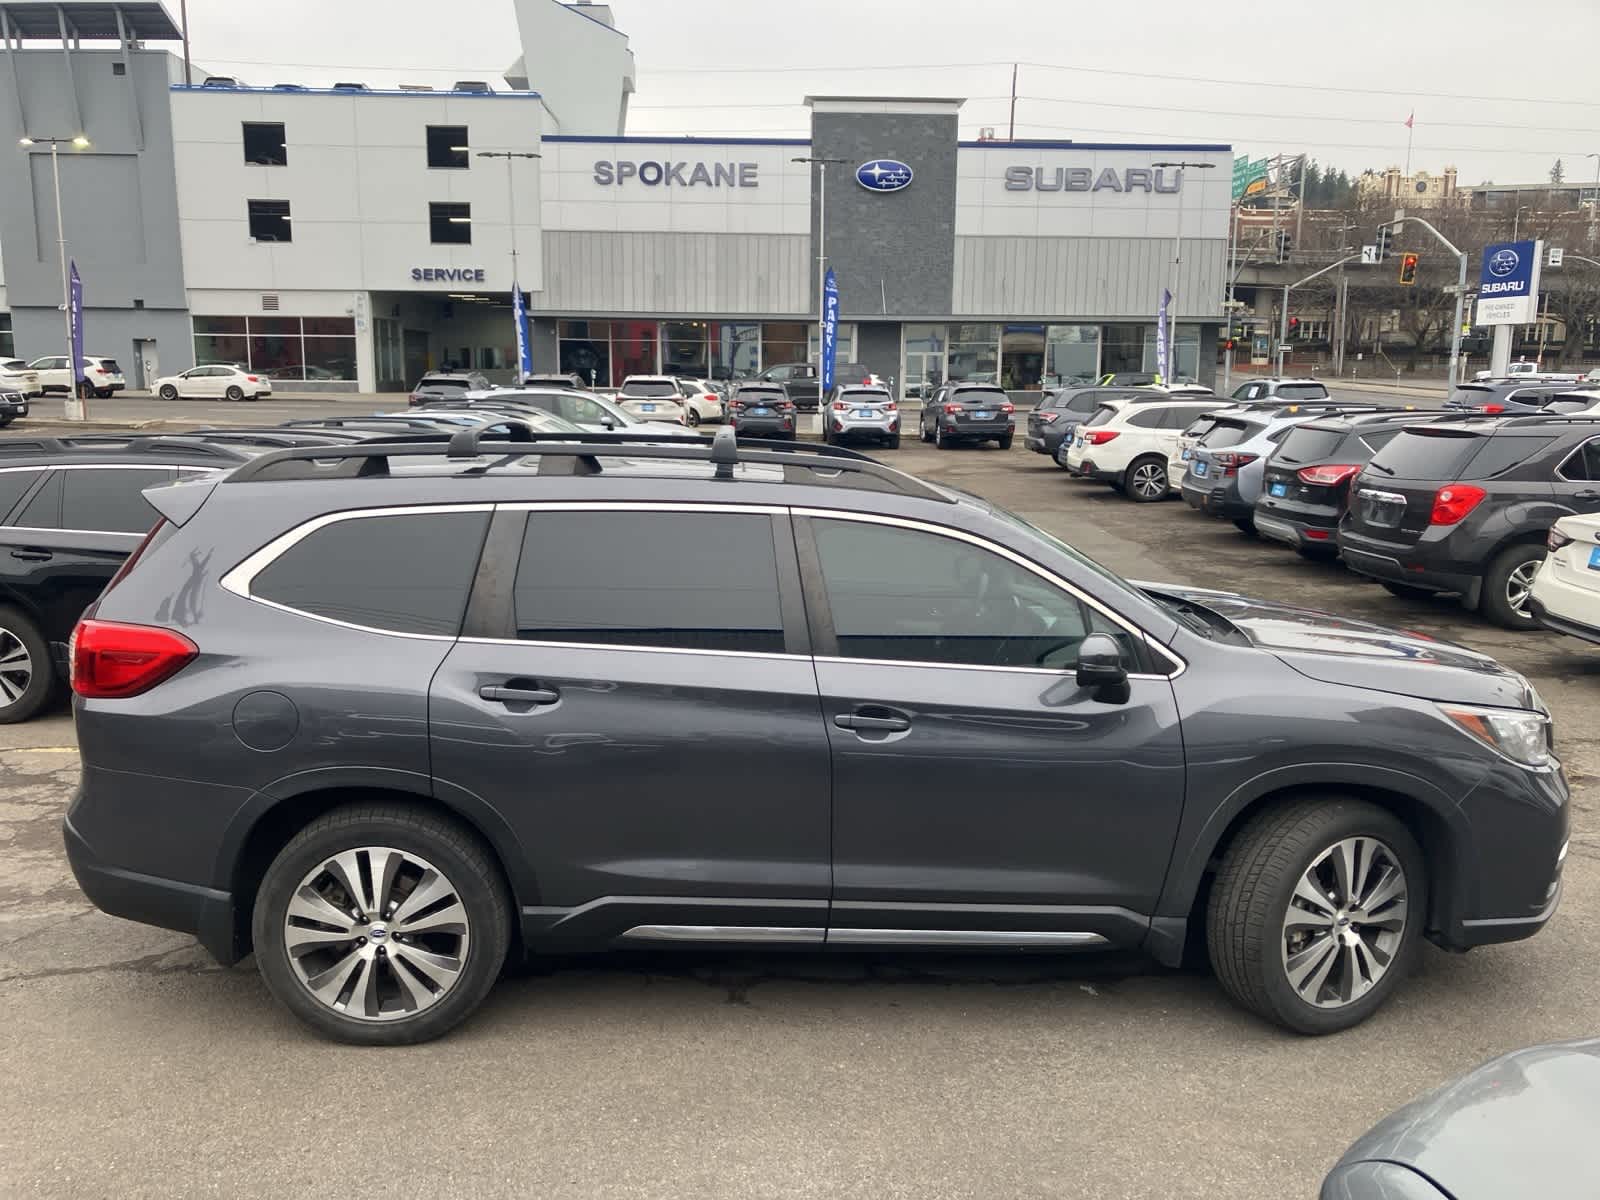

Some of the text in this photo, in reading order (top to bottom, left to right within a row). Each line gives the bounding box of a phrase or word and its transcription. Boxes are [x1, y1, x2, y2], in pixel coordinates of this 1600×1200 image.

[593, 160, 759, 188] SPOKANE
[1005, 166, 1182, 193] SUBARU
[411, 268, 485, 282] SERVICE
[1481, 280, 1525, 294] SUBARU
